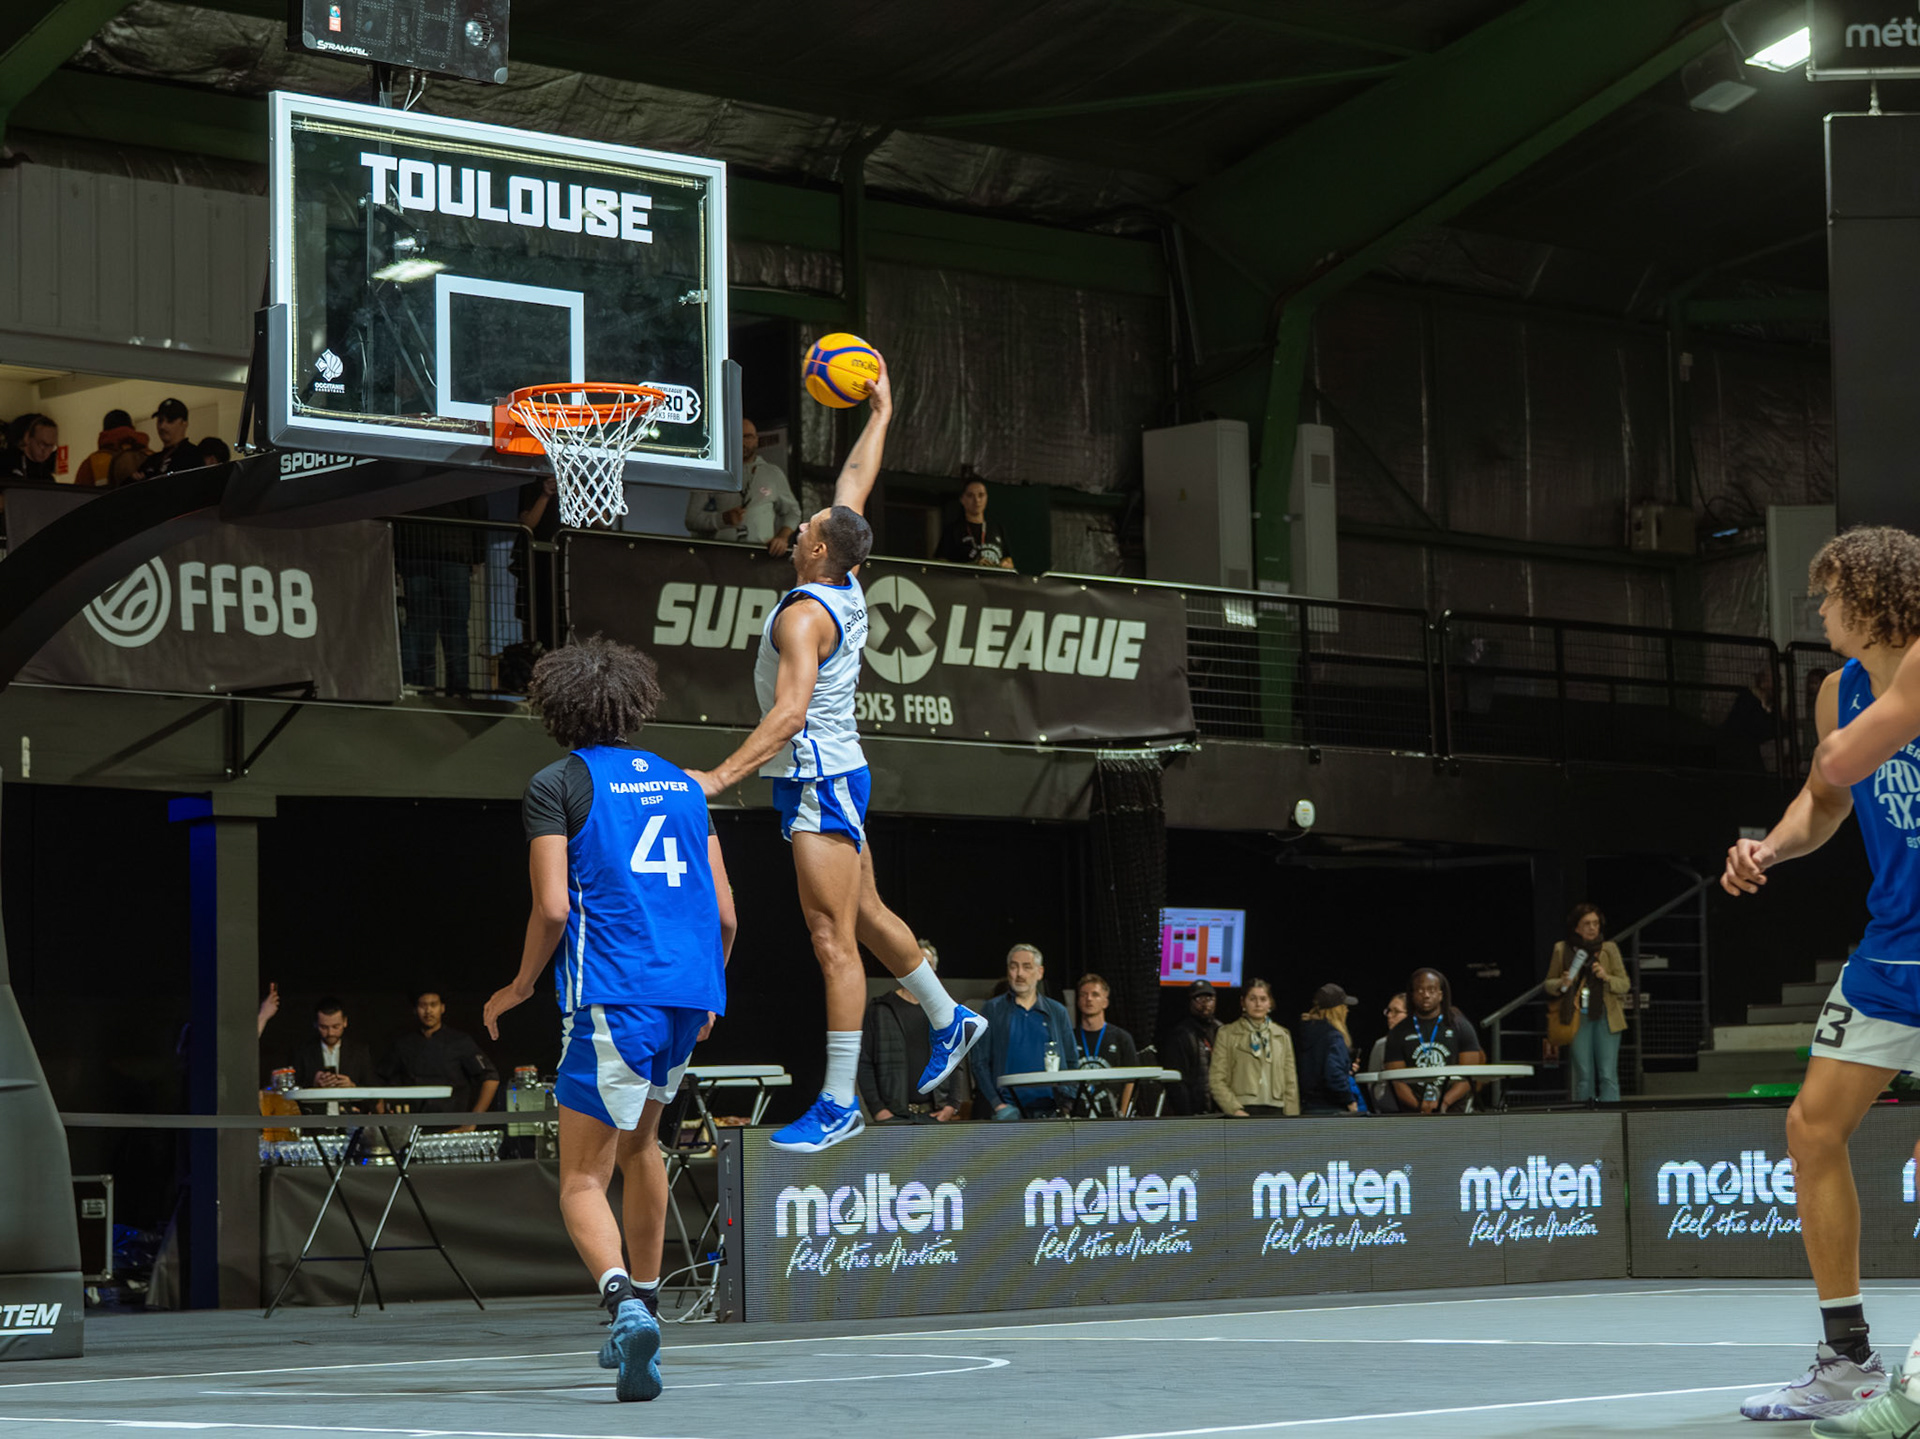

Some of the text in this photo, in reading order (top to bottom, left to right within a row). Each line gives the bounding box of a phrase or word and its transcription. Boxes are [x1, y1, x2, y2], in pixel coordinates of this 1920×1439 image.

[316, 40, 369, 57] STRAMATEL
[1845, 17, 1920, 48] mét
[360, 152, 653, 244] TOULOUSE
[179, 561, 318, 639] FFBB
[653, 582, 787, 650] SUP
[942, 604, 1147, 680] LEAGUE
[855, 692, 954, 726] 3X3 FFBB
[610, 781, 689, 794] HANNOVER
[640, 795, 664, 806] BSP
[1878, 793, 1920, 830] 3X
[630, 814, 688, 887] 4
[1906, 836, 1920, 849] BS
[1814, 1002, 1854, 1049] 3
[1024, 1166, 1198, 1227] molten
[1252, 1160, 1412, 1219] molten
[1460, 1155, 1602, 1212] molten
[1657, 1150, 1797, 1205] molte
[776, 1173, 964, 1238] molten
[1667, 1204, 1715, 1240] feel
[1712, 1209, 1749, 1236] the
[1033, 1225, 1081, 1266] feel
[1079, 1230, 1114, 1260] the
[1261, 1218, 1304, 1257] feel
[1302, 1222, 1335, 1251] the
[1468, 1209, 1508, 1248] feel
[1506, 1215, 1535, 1242] the
[786, 1235, 837, 1279] feel
[835, 1241, 873, 1271] the
